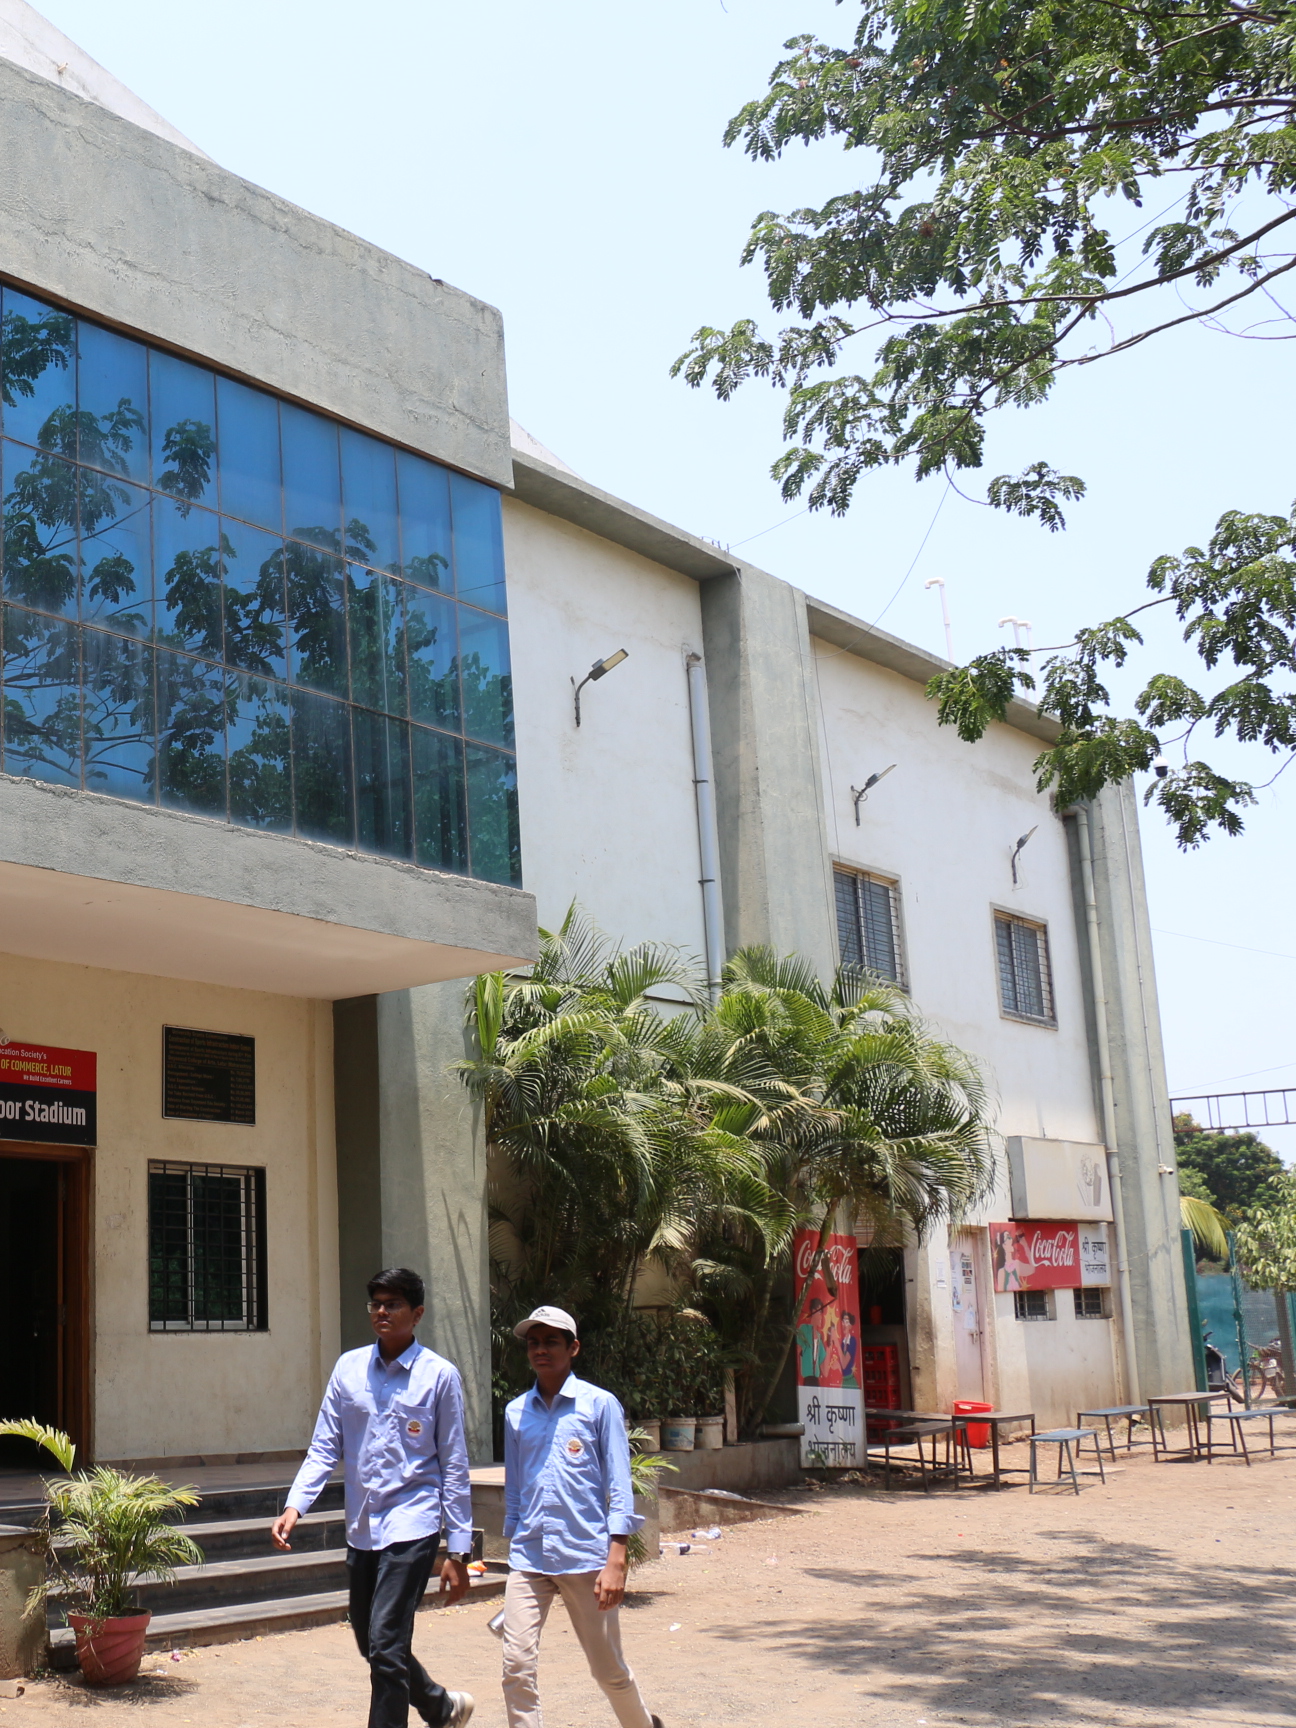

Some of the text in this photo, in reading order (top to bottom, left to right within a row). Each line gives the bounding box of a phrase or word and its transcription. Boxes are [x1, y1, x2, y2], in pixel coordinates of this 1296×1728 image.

[20, 1049, 47, 1060] Society's
[1, 1058, 10, 1070] OF
[11, 1060, 49, 1076] COMMERCE,
[51, 1064, 72, 1077] LATUR
[25, 1100, 86, 1126] Stadium
[806, 1396, 856, 1434] श्री कृष्णा
